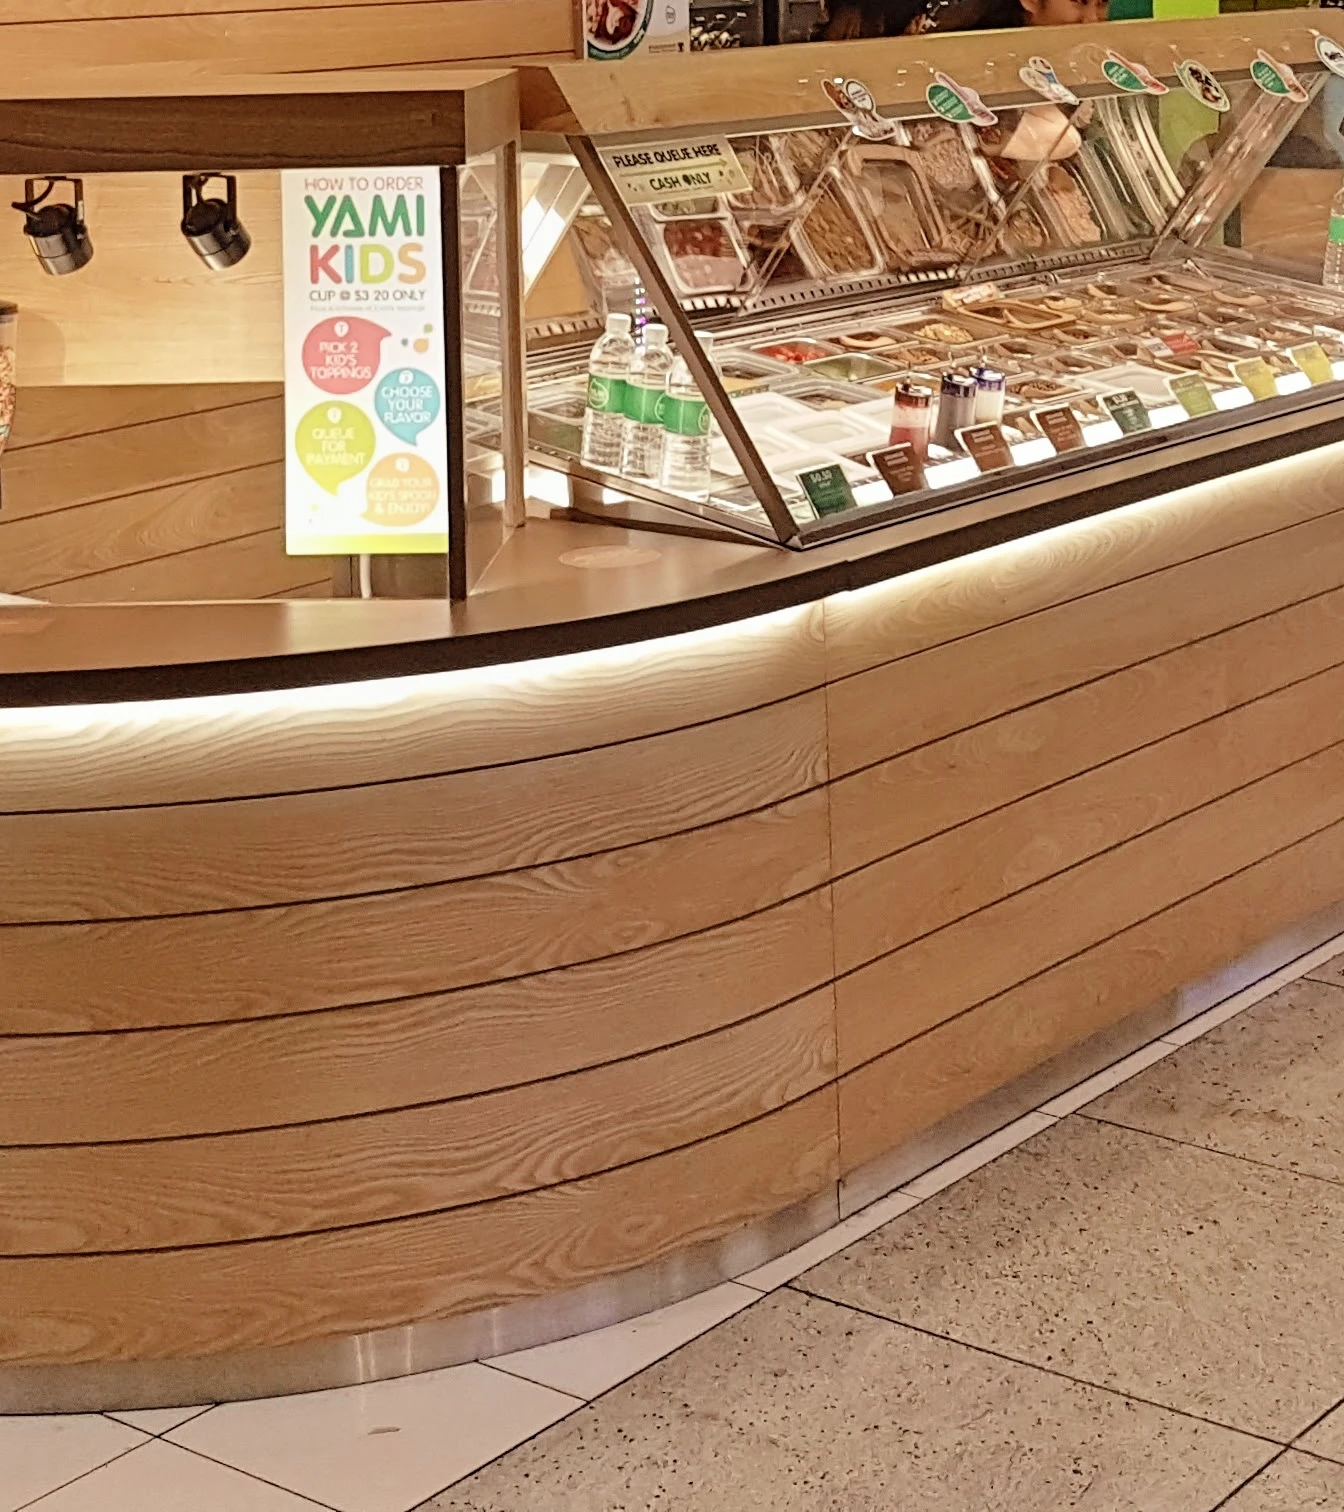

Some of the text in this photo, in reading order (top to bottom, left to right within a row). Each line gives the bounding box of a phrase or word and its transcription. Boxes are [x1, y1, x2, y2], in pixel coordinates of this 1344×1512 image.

[611, 143, 722, 169] PLEASE QUEUE HERE
[304, 176, 424, 192] HOW TO ORDER
[649, 171, 712, 191] CASH ONLY
[304, 194, 425, 238] YAMI
[309, 242, 427, 284] KIDS
[309, 290, 336, 302] CUP
[355, 290, 389, 301] $320
[392, 290, 427, 301] ONLY
[319, 341, 359, 353] PICK 2
[310, 366, 372, 380] TOPPINGS
[381, 386, 433, 398] CHOOSE
[387, 399, 424, 411] YOUR
[384, 411, 432, 424] FLAVOR
[321, 440, 346, 452] FOR
